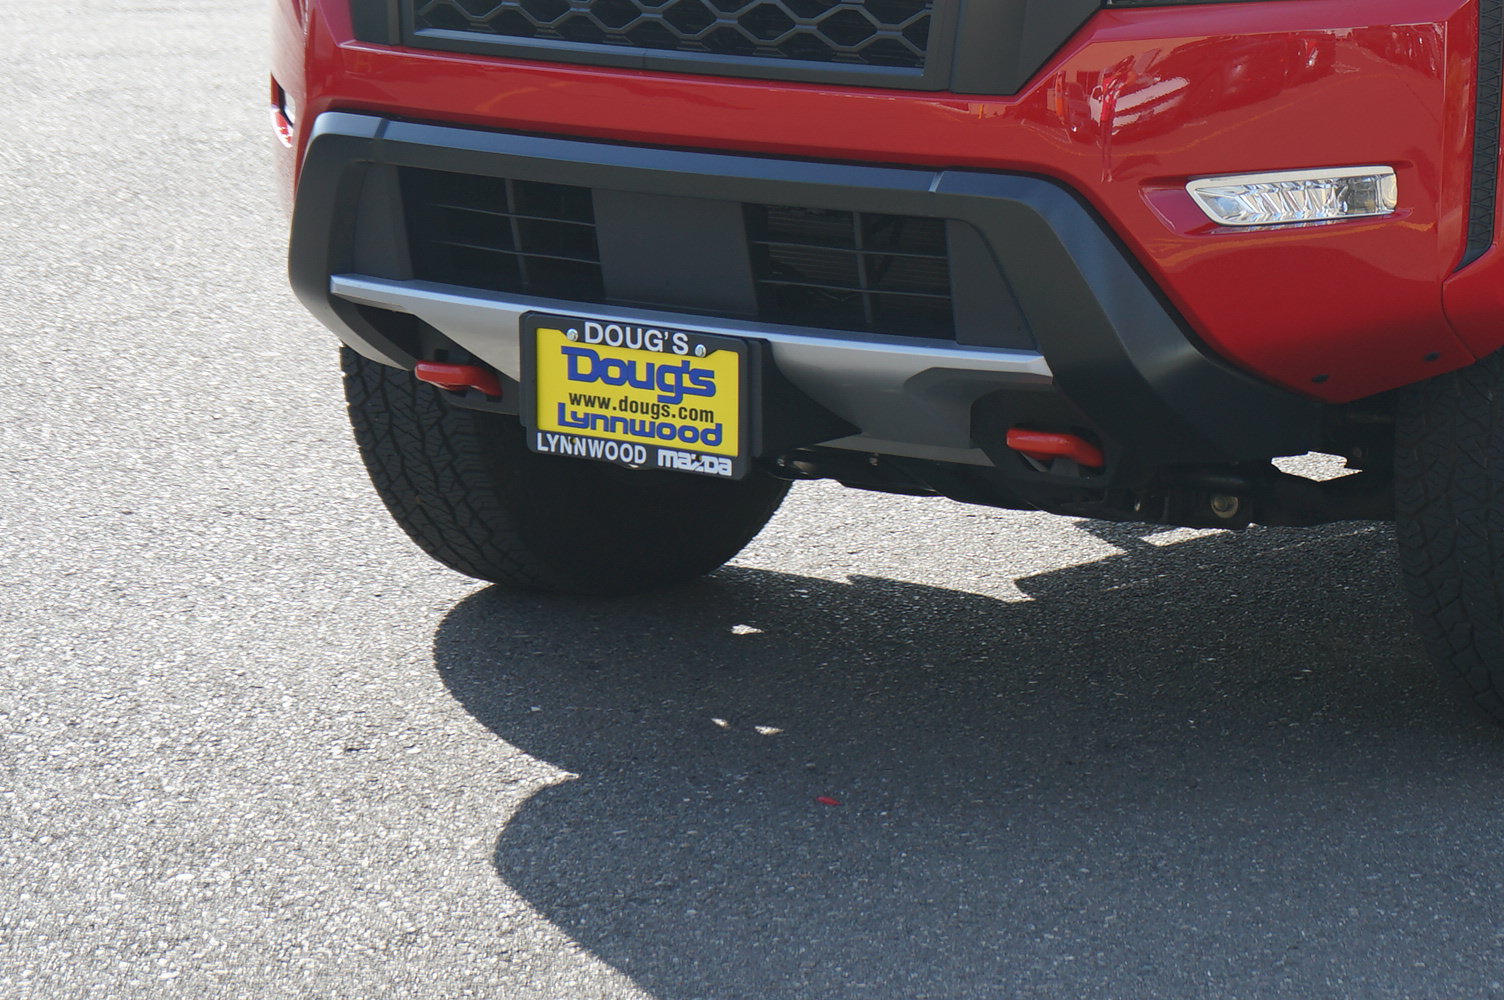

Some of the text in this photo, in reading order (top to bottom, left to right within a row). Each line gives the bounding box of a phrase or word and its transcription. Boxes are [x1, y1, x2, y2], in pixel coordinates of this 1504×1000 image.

[584, 321, 689, 356] DOUG'S
[557, 402, 723, 447] Lynnwood
[568, 392, 715, 424] www.dougs.com
[536, 432, 648, 465] LYNNWOOD
